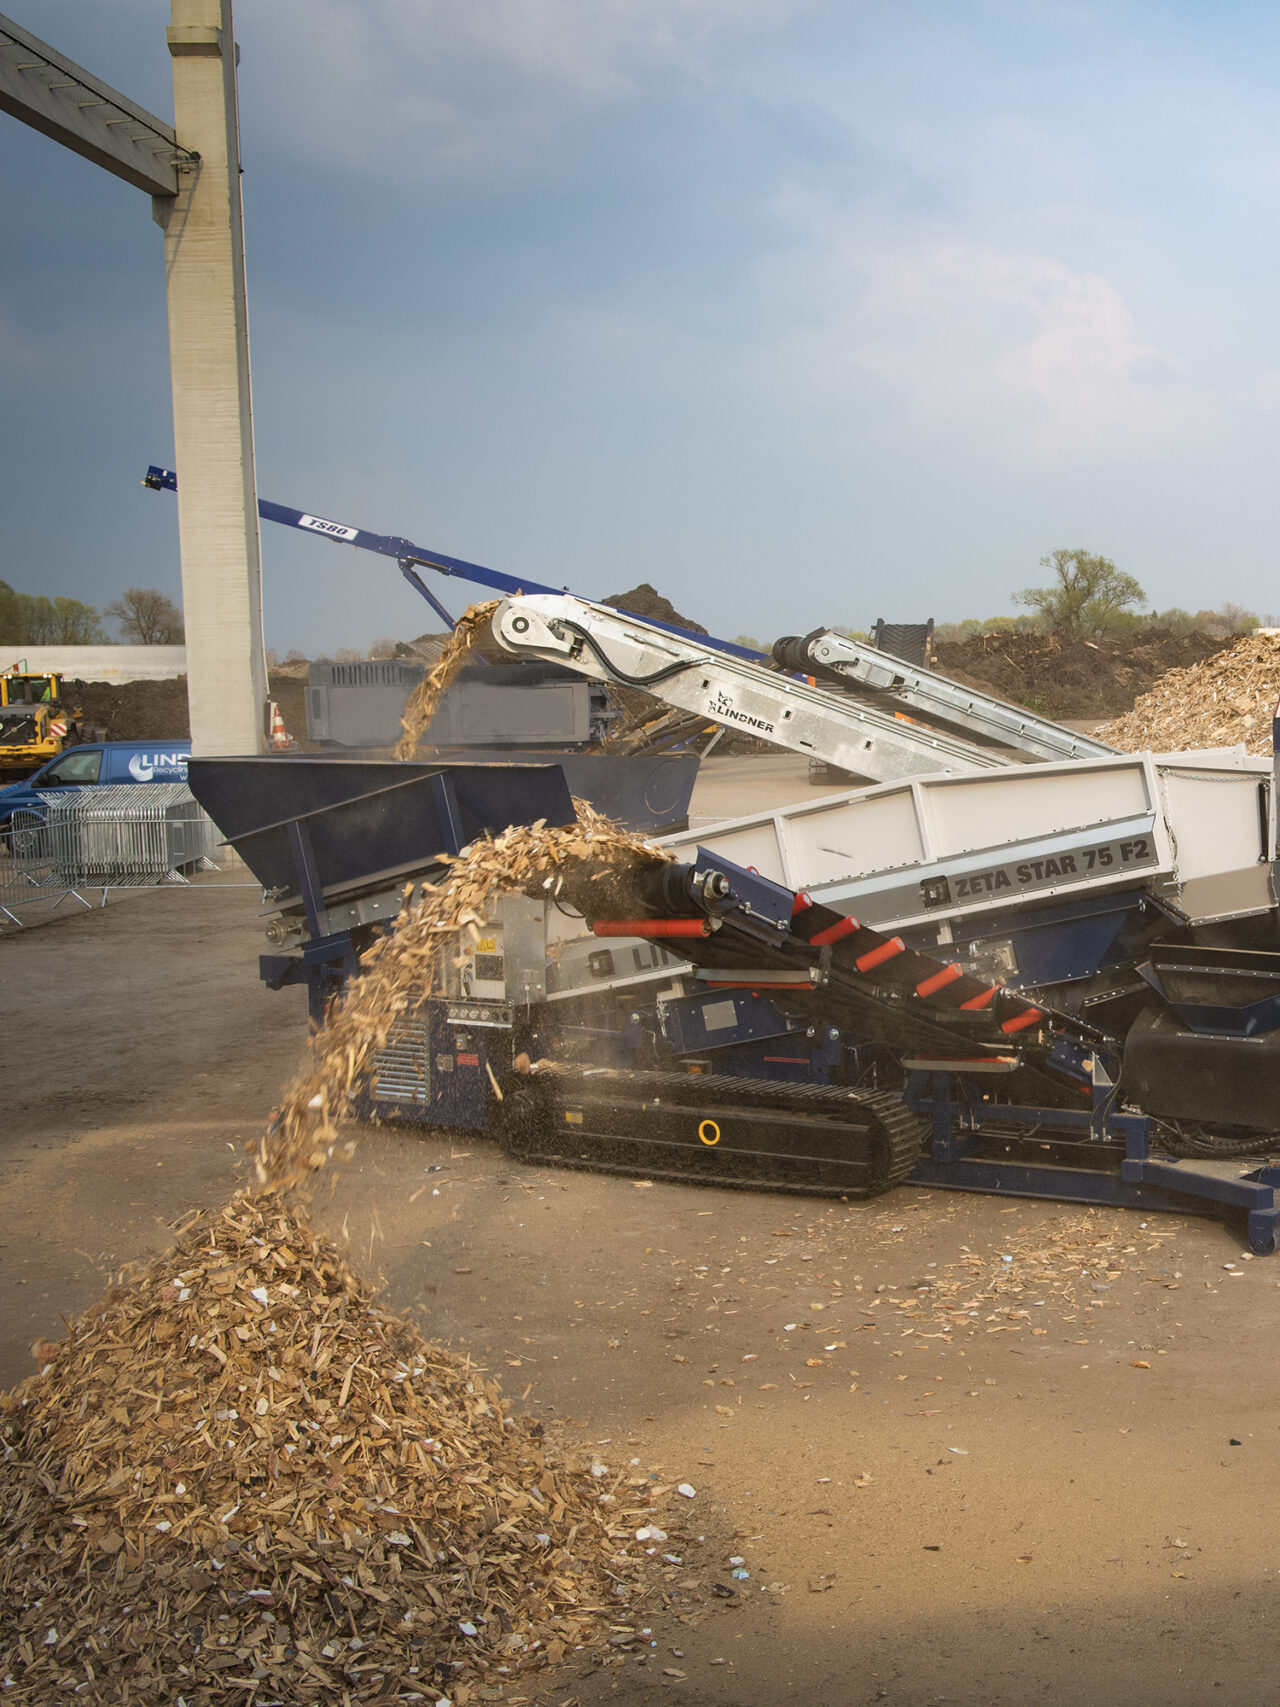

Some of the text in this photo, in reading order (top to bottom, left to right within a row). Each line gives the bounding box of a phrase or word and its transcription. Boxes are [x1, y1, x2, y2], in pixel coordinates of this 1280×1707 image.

[309, 519, 349, 535] TS80
[717, 705, 775, 733] LINDNER
[153, 766, 188, 775] Recyclin
[954, 839, 1150, 897] ZETA STAR 75 F2
